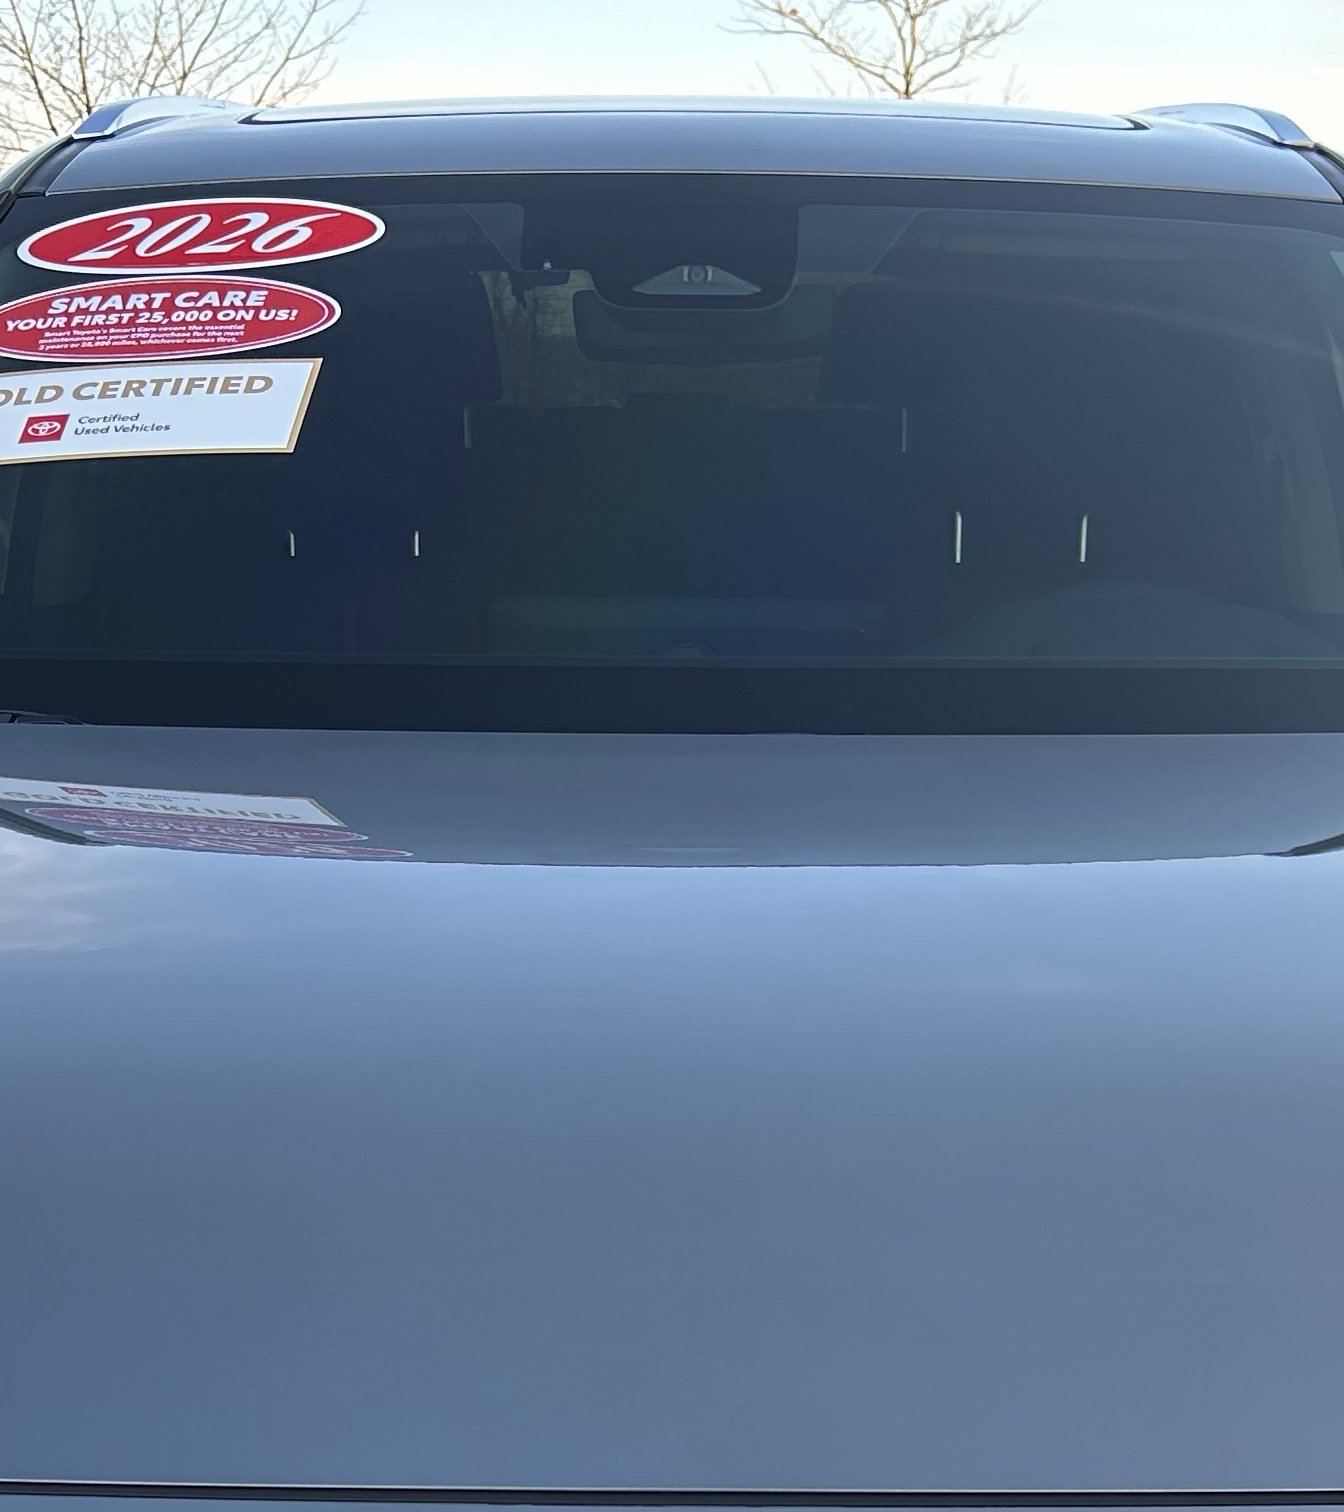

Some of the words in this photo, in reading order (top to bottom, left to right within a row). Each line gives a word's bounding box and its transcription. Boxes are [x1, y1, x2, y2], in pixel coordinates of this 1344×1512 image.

[67, 211, 342, 262] 2026
[47, 292, 171, 315] SMART
[174, 290, 269, 308] CARE
[6, 315, 67, 332] YOUR
[70, 312, 134, 327] FIRST
[135, 310, 211, 325] 25,000
[216, 309, 256, 322] ON
[257, 308, 299, 321] US!
[71, 375, 274, 401] CERTIFIED
[74, 424, 113, 436] Used
[113, 421, 172, 434] Vehicles
[77, 412, 140, 425] Certified
